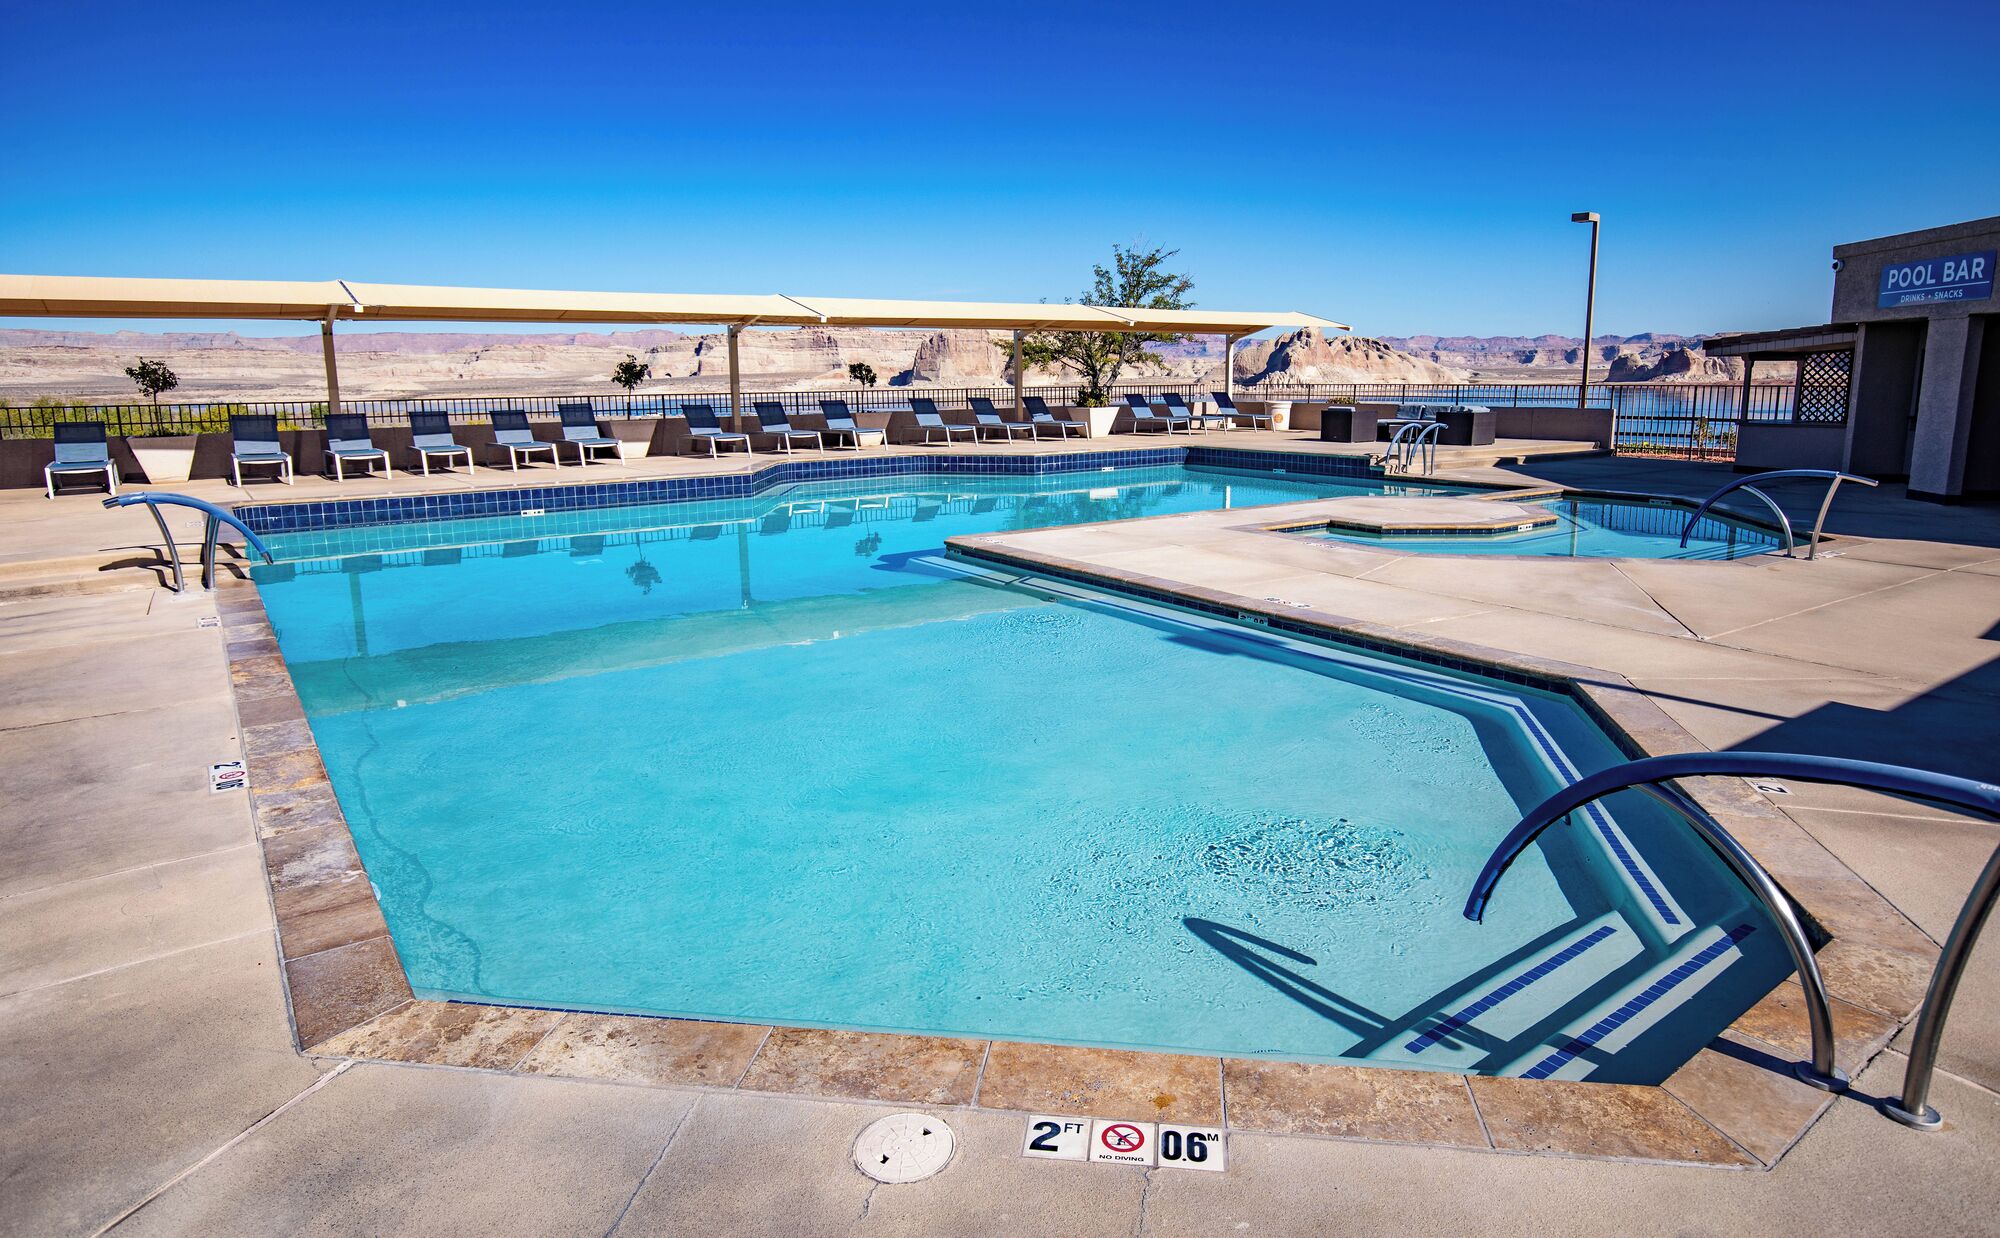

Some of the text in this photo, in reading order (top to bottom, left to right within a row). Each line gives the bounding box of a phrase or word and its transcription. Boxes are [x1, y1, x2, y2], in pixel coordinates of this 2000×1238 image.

[1887, 257, 1985, 289] POOL BAR
[1900, 289, 1963, 303] DRINKS SNACKS
[1029, 1121, 1084, 1152] 2 FT
[1161, 1130, 1208, 1163] 0.6
